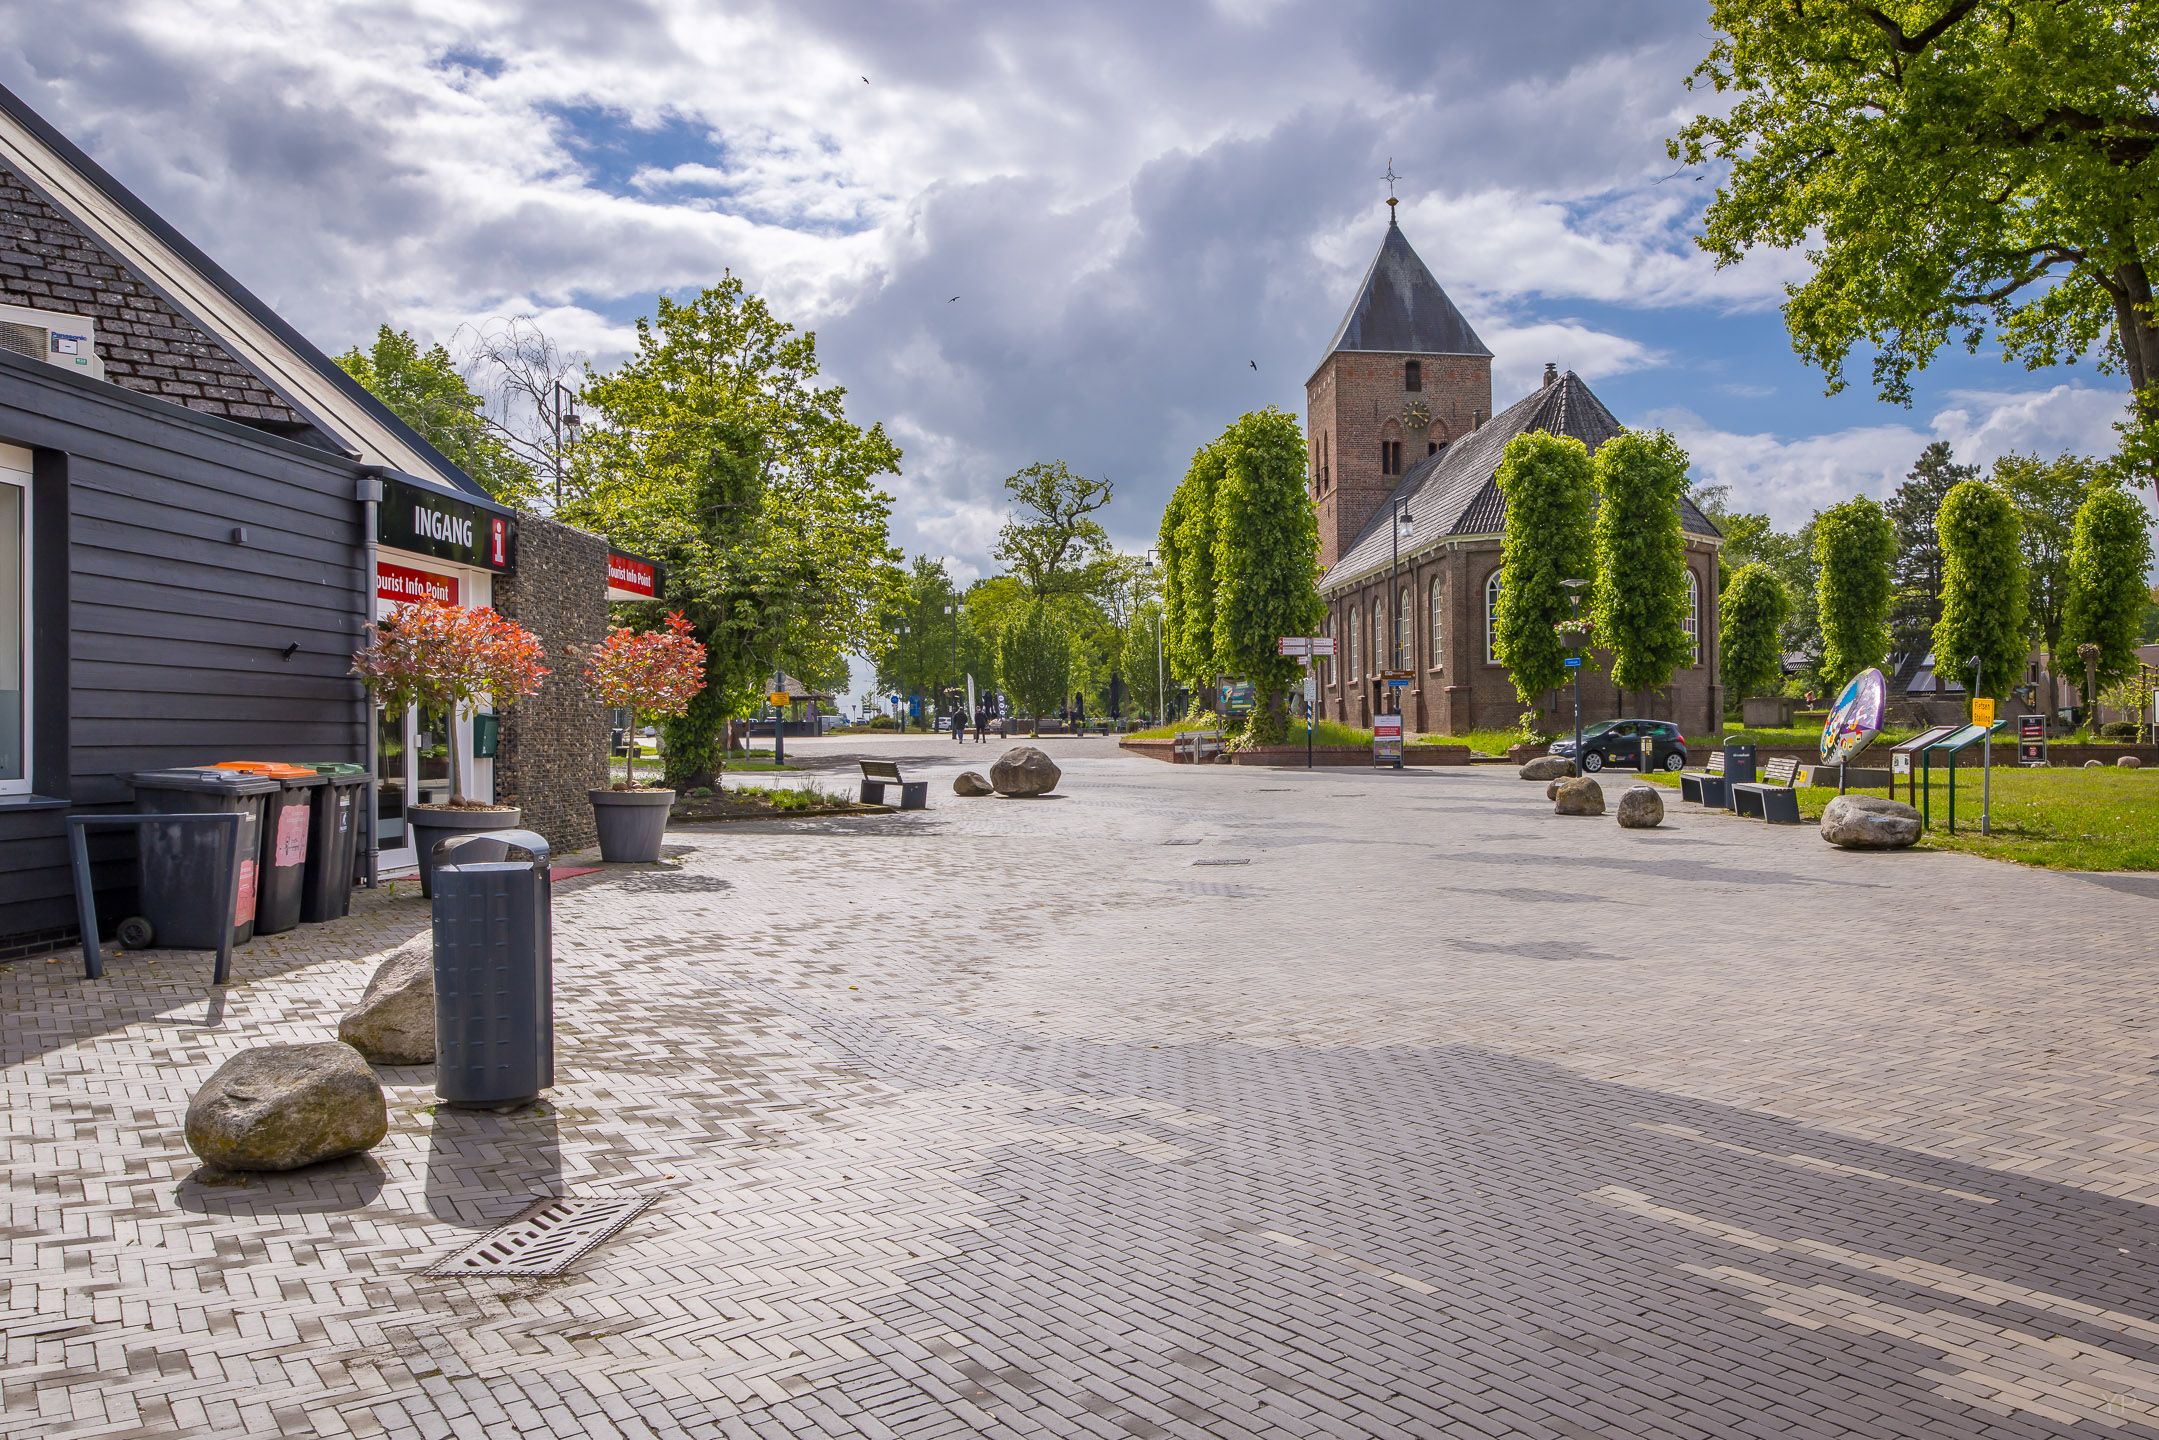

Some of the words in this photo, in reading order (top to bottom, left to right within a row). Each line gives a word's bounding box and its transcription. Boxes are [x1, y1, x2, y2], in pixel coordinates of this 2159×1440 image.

[52, 331, 87, 340] Panasonic
[415, 505, 473, 548] INGANG
[376, 573, 403, 593] ourist
[405, 577, 424, 596] Info
[426, 581, 449, 601] Point
[626, 569, 637, 584] Info
[637, 572, 651, 588] Point
